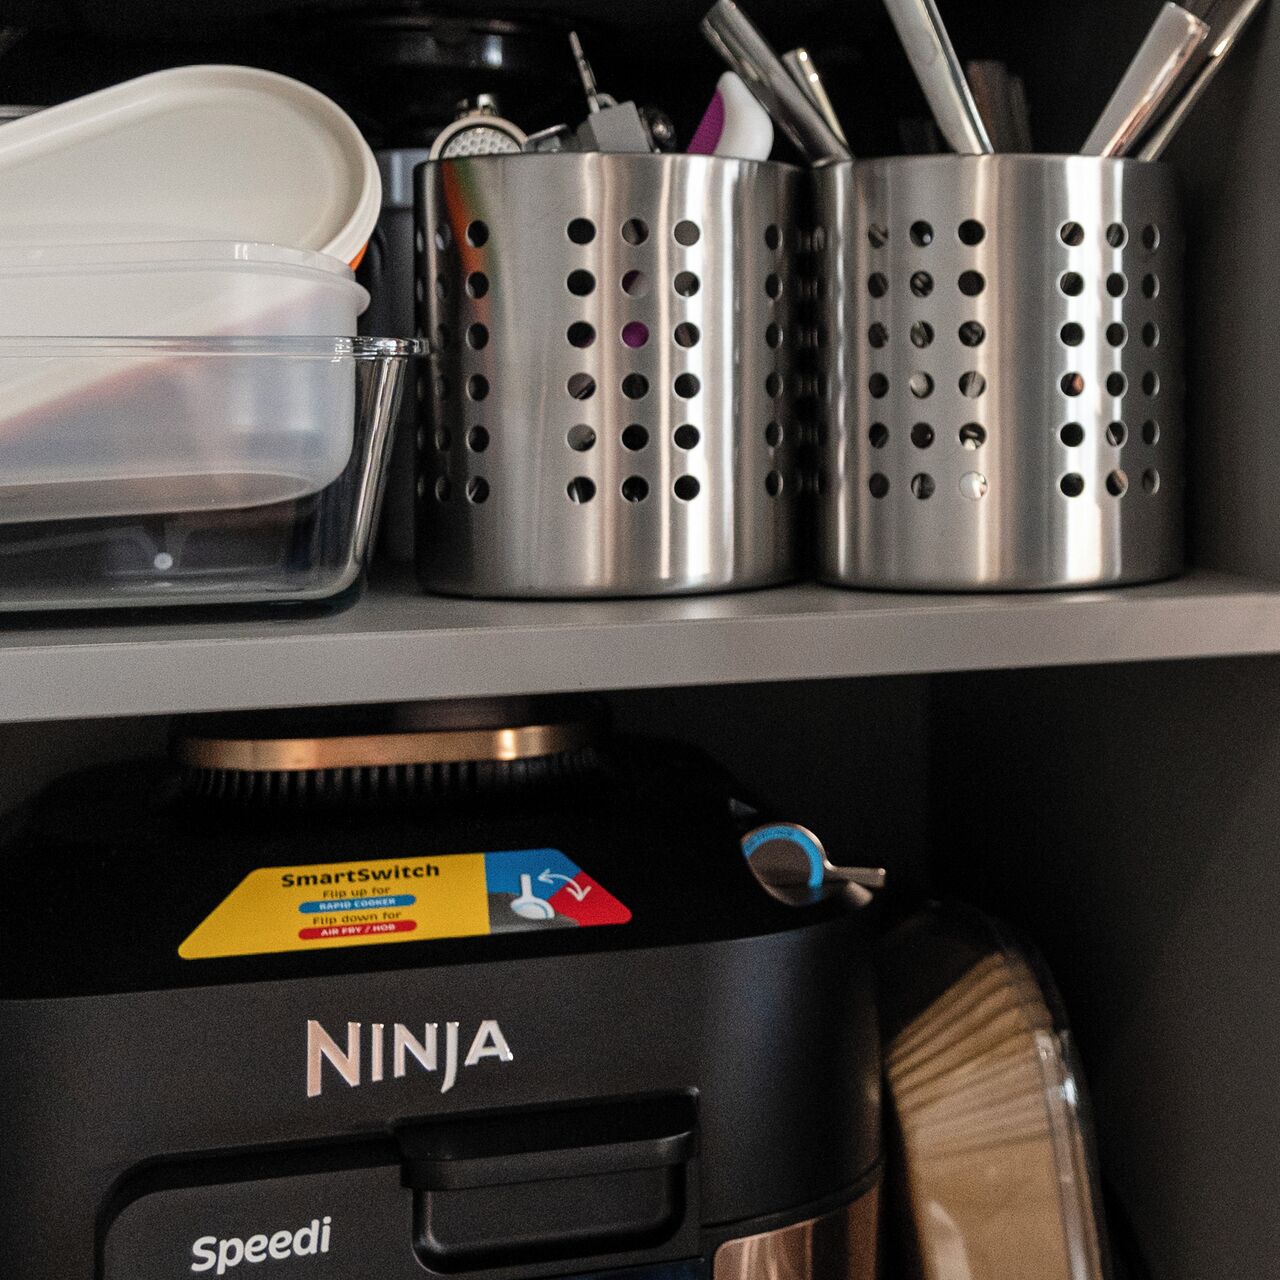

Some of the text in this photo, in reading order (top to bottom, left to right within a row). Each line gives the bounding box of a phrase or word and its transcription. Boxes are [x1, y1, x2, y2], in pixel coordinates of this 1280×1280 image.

[281, 864, 440, 888] SmartSwitch
[323, 886, 391, 900] Flip up for
[319, 897, 396, 910] RAPID COOKER
[312, 910, 402, 926] Flip down for
[320, 928, 339, 937] AIR
[341, 926, 362, 935] FRY
[373, 923, 396, 933] HOB
[307, 1020, 513, 1098] NINJA
[191, 1216, 332, 1275] Speedi
